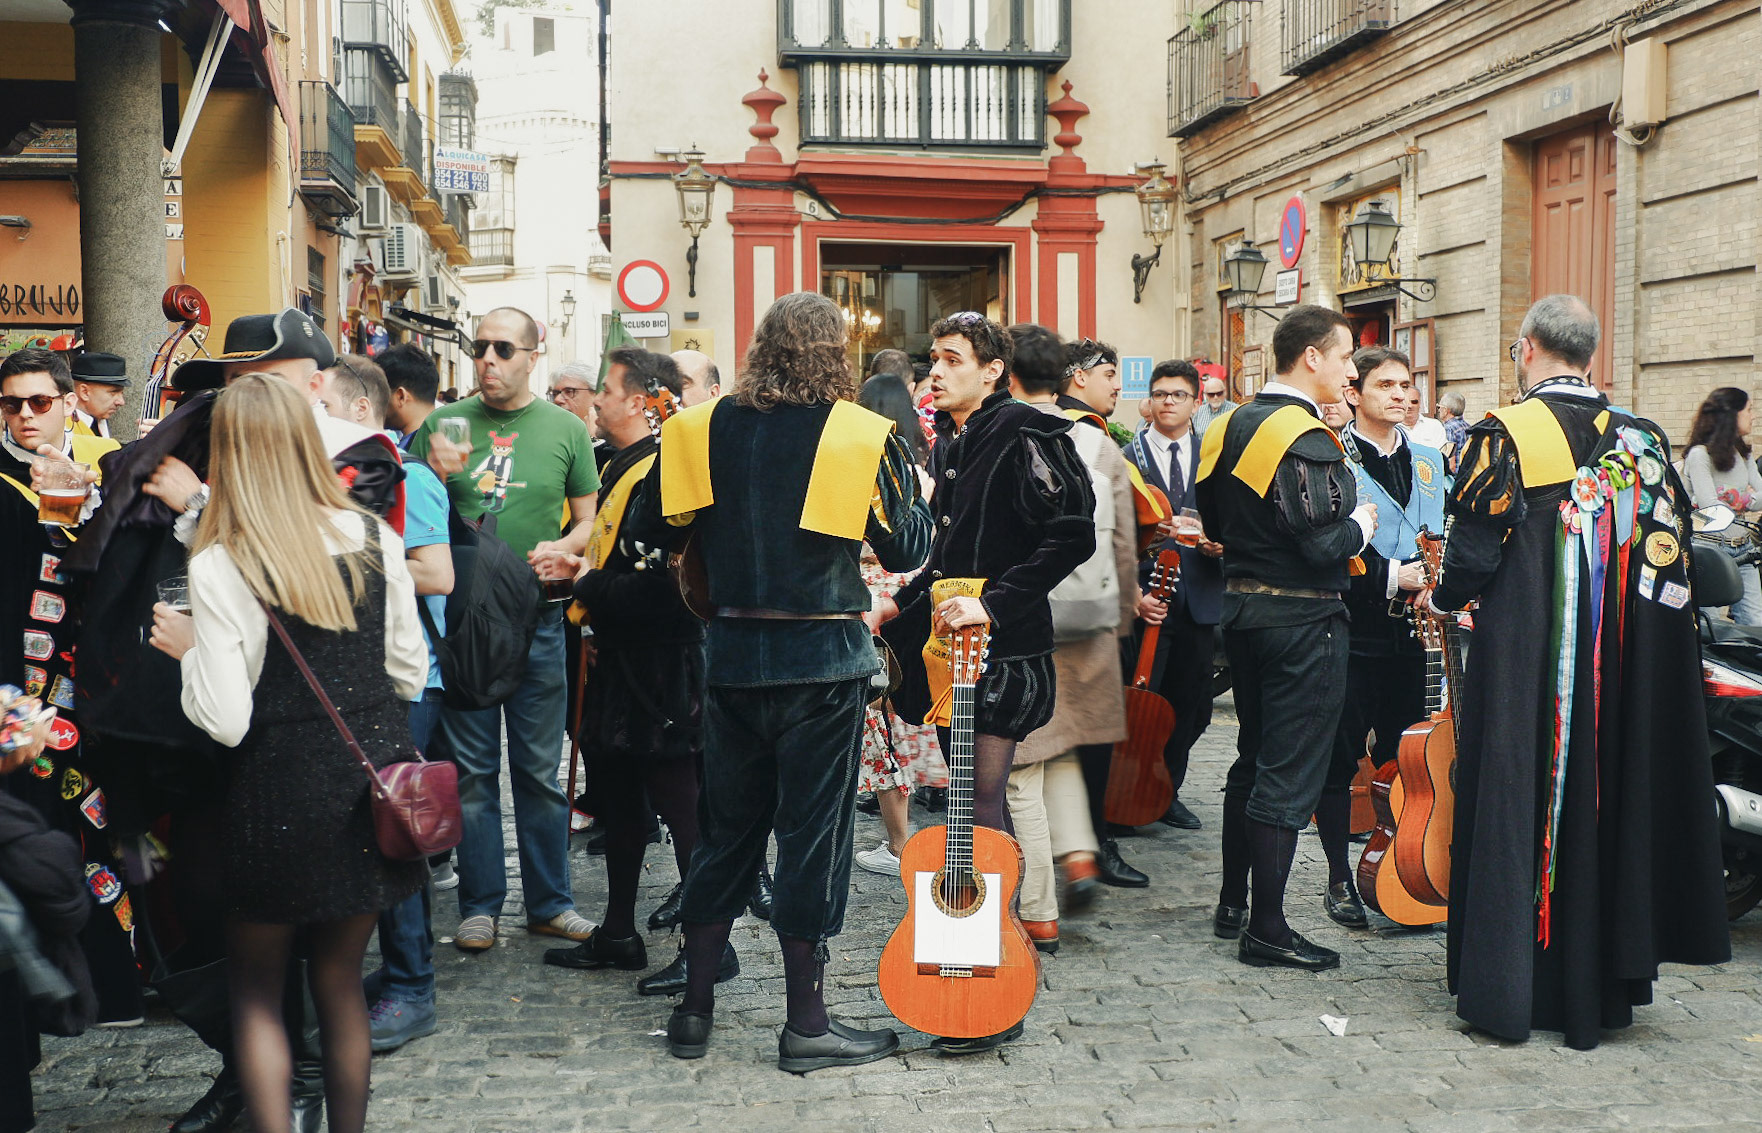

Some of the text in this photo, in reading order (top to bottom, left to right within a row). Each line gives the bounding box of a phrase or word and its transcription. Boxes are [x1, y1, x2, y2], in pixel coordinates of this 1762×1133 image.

[436, 148, 487, 161] ALQUICASA
[436, 161, 487, 171] DISPONIBLE
[435, 169, 488, 182] 954 221 600
[435, 177, 488, 191] 654 546 755
[808, 201, 816, 214] 6
[0, 283, 79, 316] BRUJO
[623, 320, 667, 329] NCLUSO BICI
[1129, 361, 1145, 381] H
